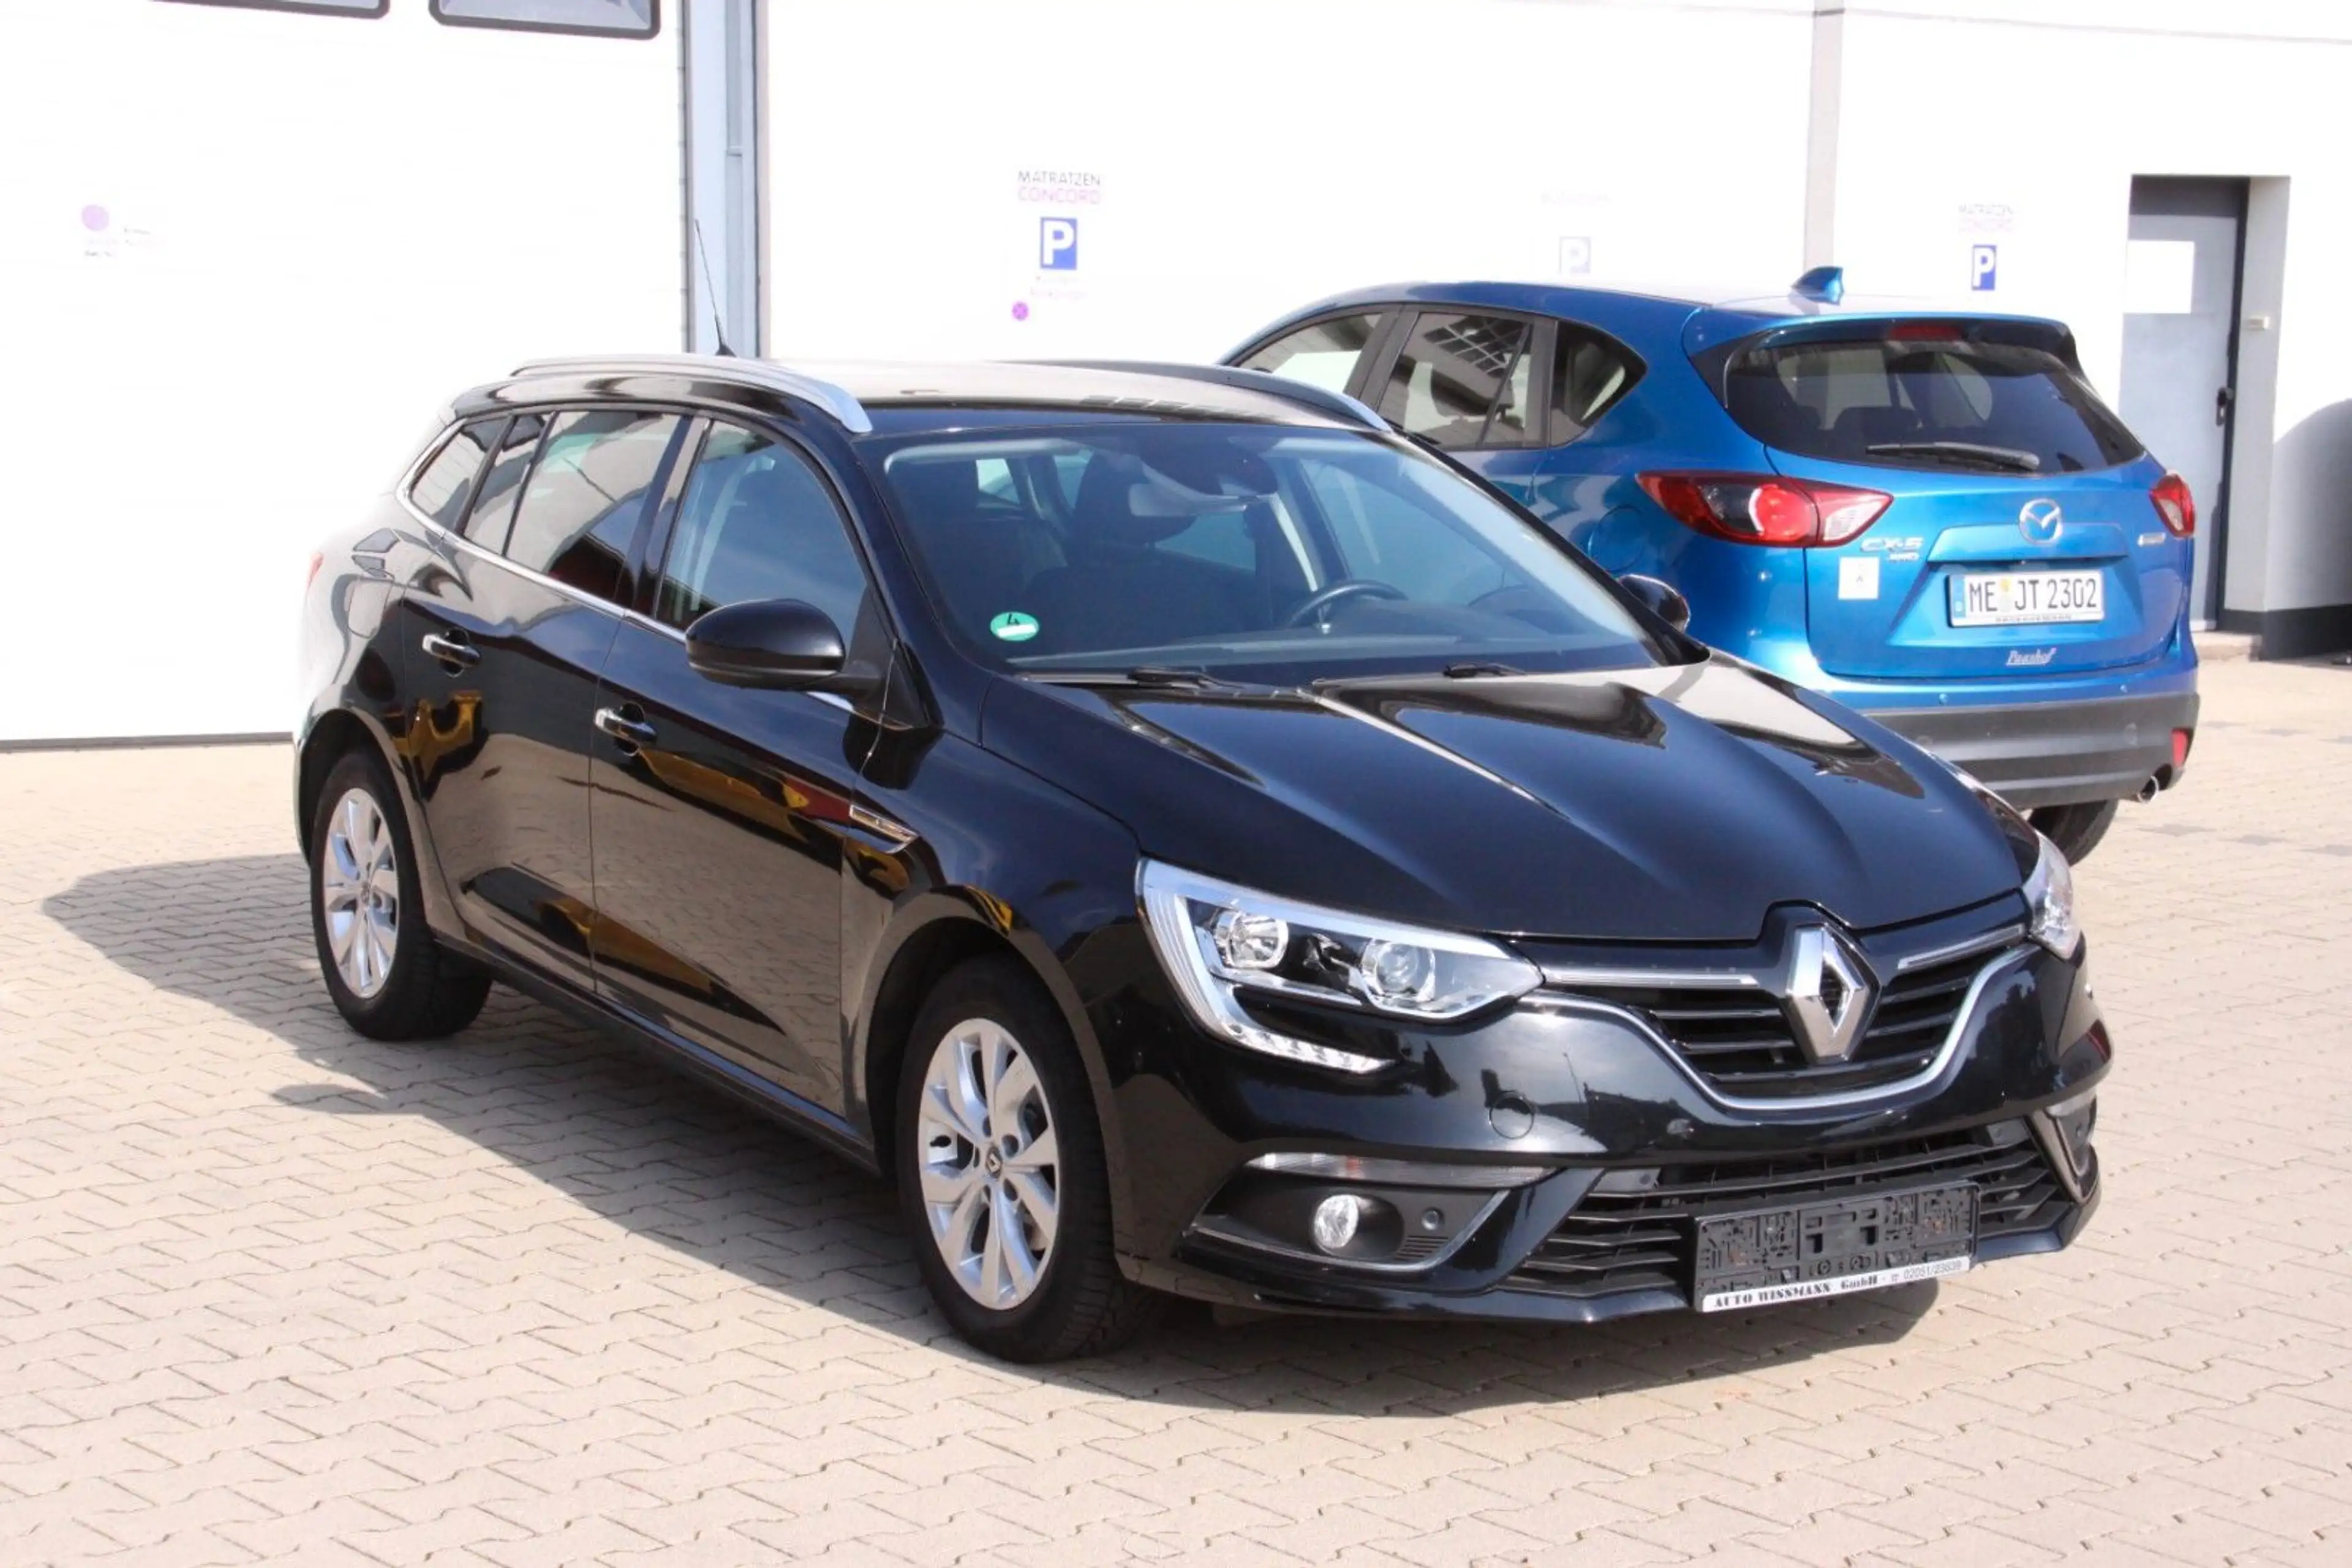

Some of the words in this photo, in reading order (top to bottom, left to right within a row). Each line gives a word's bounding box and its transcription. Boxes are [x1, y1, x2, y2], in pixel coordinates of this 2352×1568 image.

[1017, 170, 1101, 186] MATRATZEN
[1017, 186, 1102, 205] CONCORD
[1043, 221, 1074, 265] P
[1973, 247, 1994, 286] P
[1969, 581, 1998, 612] ME
[2014, 579, 2040, 611] JT
[2046, 578, 2097, 609] 2302
[1714, 1293, 1753, 1308] AUTO
[1758, 1282, 1831, 1302] WISSMANN
[1840, 1275, 1878, 1290] GmbH
